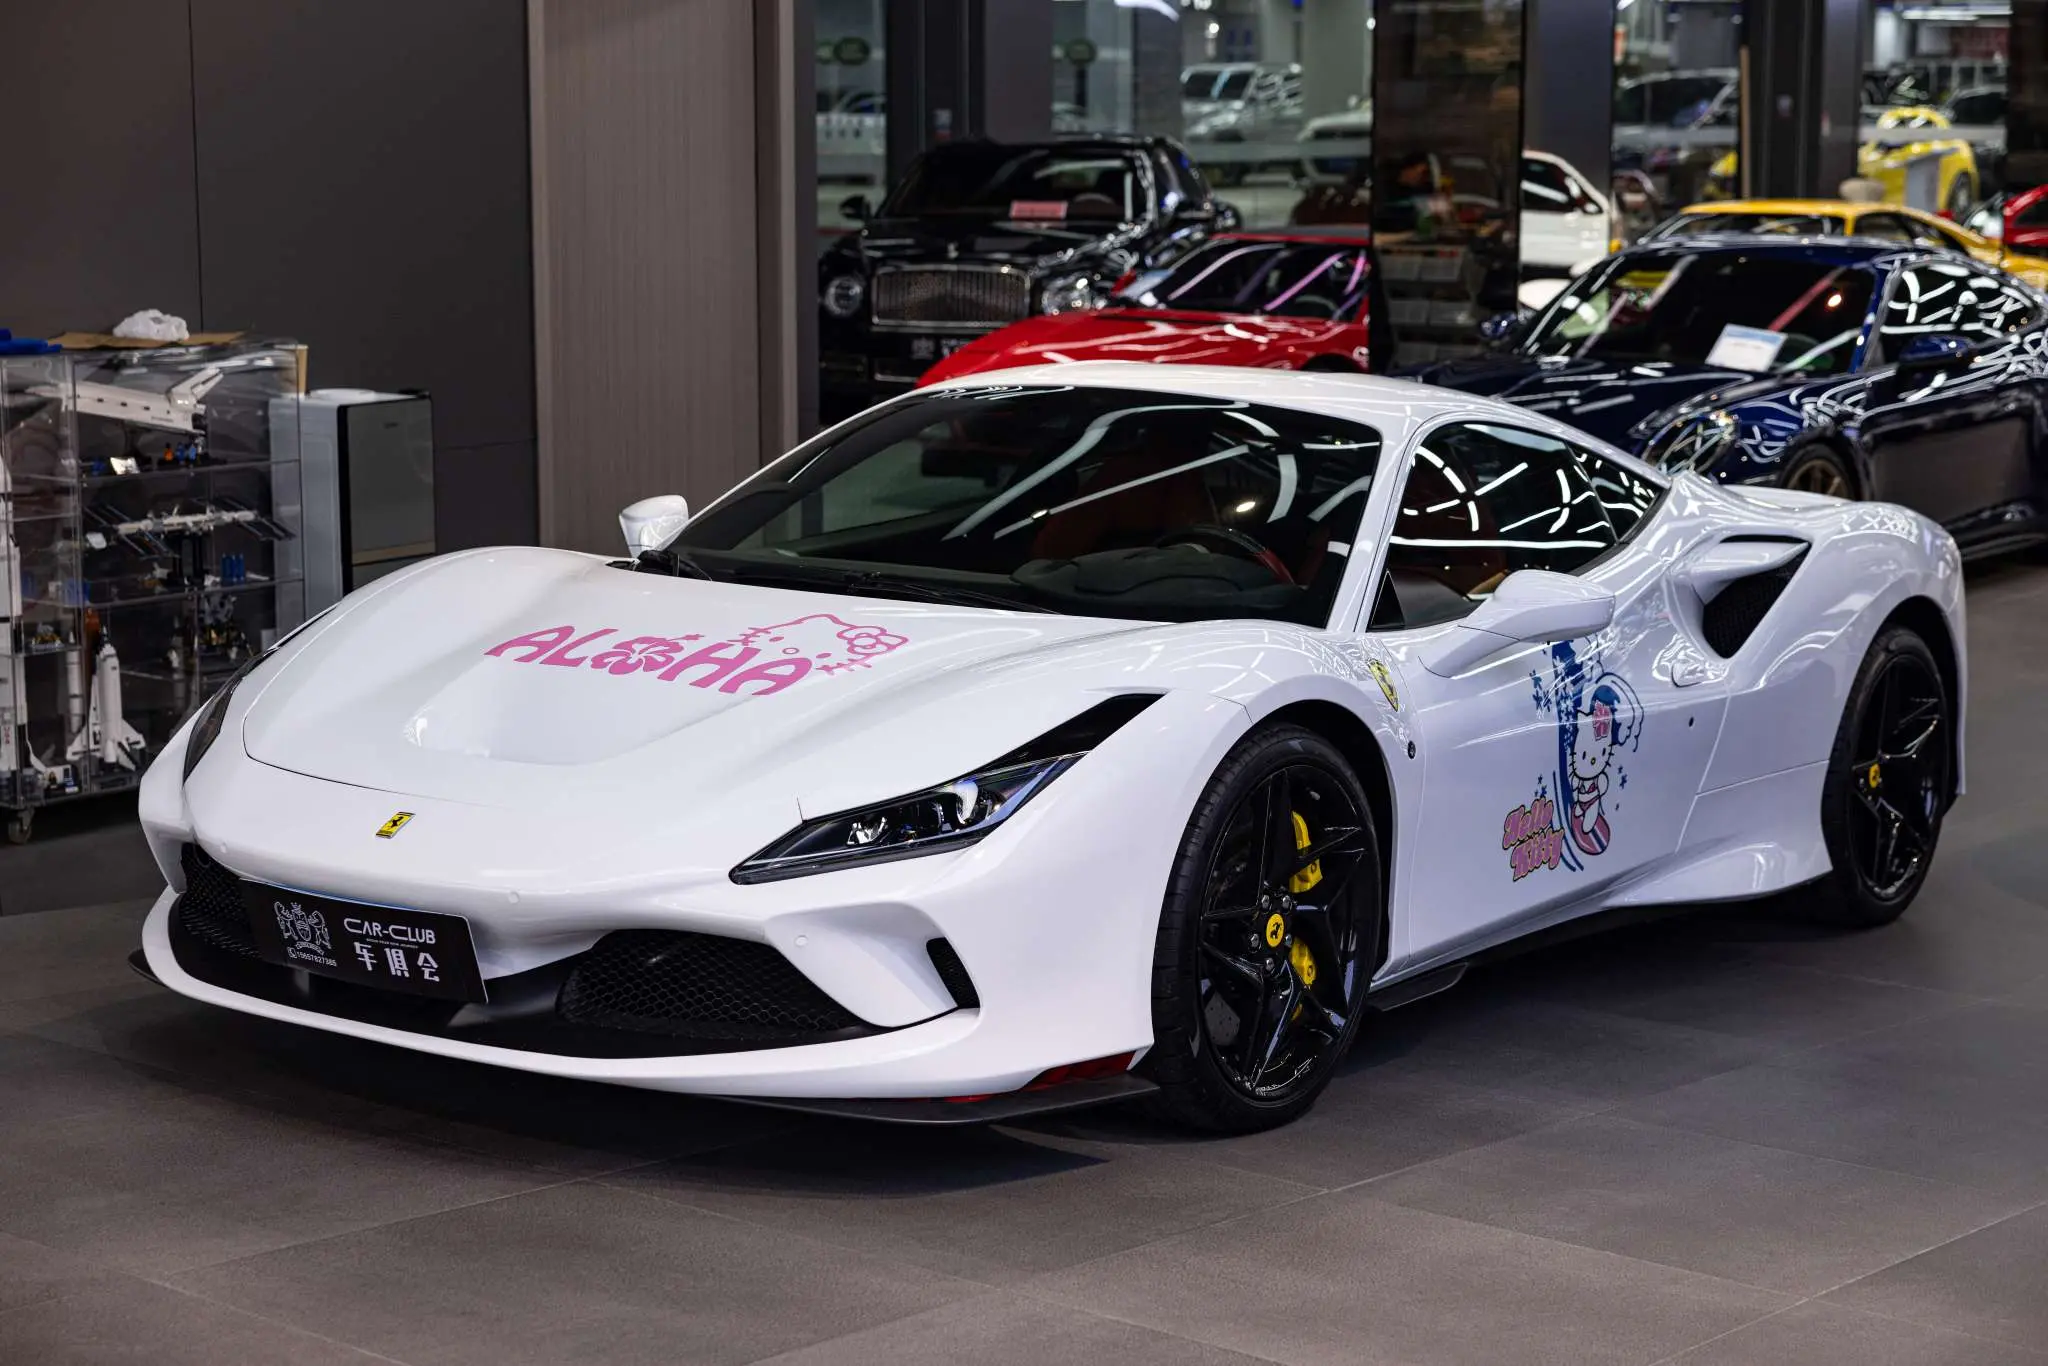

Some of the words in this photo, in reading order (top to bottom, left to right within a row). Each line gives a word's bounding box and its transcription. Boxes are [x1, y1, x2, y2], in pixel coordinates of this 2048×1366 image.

[483, 625, 813, 696] ALOHA
[1502, 797, 1554, 850] Hello
[343, 918, 436, 945] CAR-CLUB
